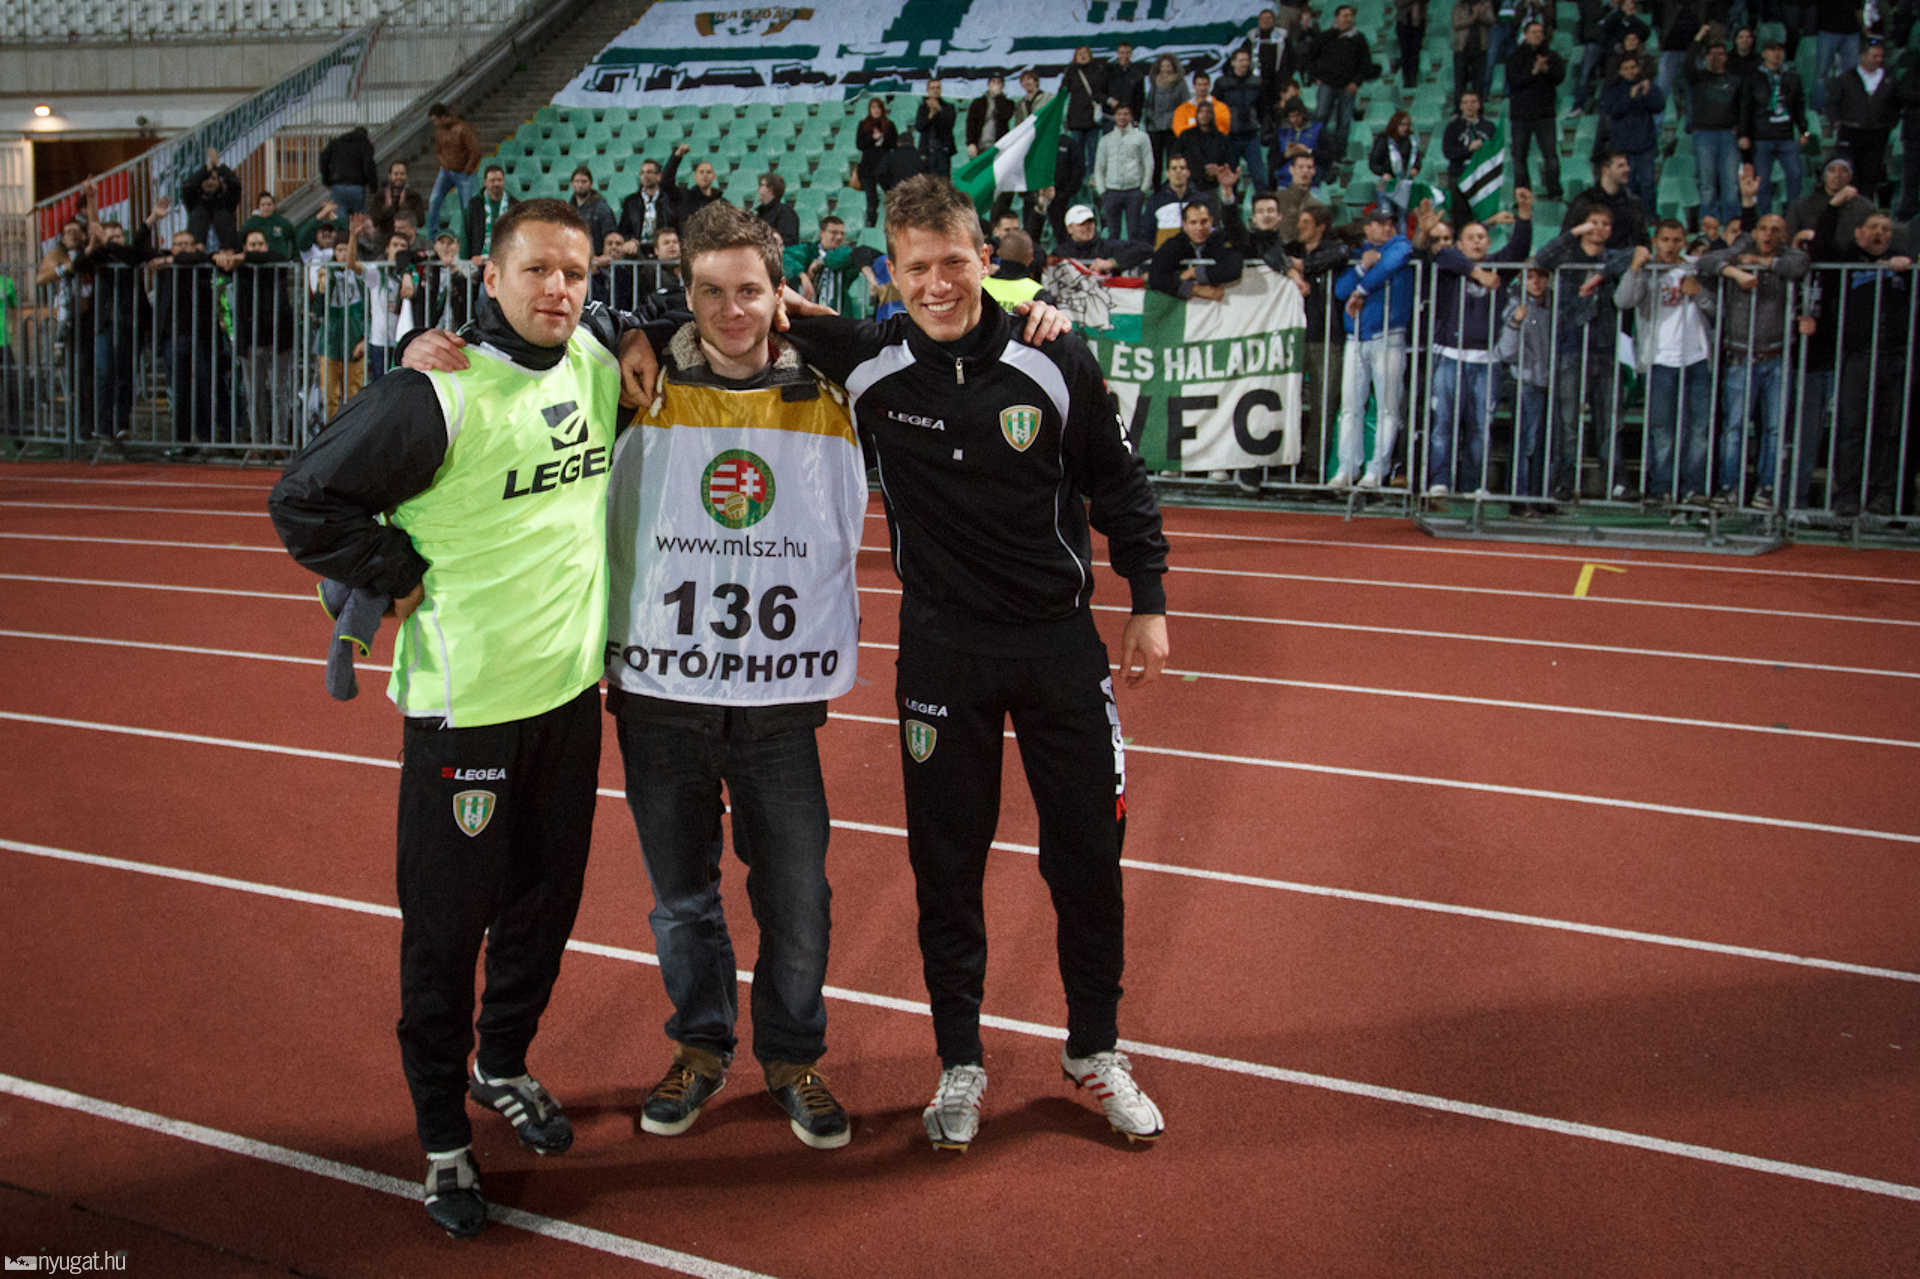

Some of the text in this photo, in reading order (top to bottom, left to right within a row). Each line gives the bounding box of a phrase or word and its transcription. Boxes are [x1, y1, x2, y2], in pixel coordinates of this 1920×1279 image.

[1110, 341, 1155, 382] ÉS
[1163, 331, 1295, 382] HALADÁS
[887, 409, 946, 432] LEGEA
[502, 446, 613, 500] LEGE
[656, 535, 808, 558] www.mlsz.hu
[664, 580, 798, 641] 136
[604, 642, 839, 683] FOTÓ/PHOTO
[905, 697, 948, 718] LEGEA
[454, 767, 507, 781] LEGEA
